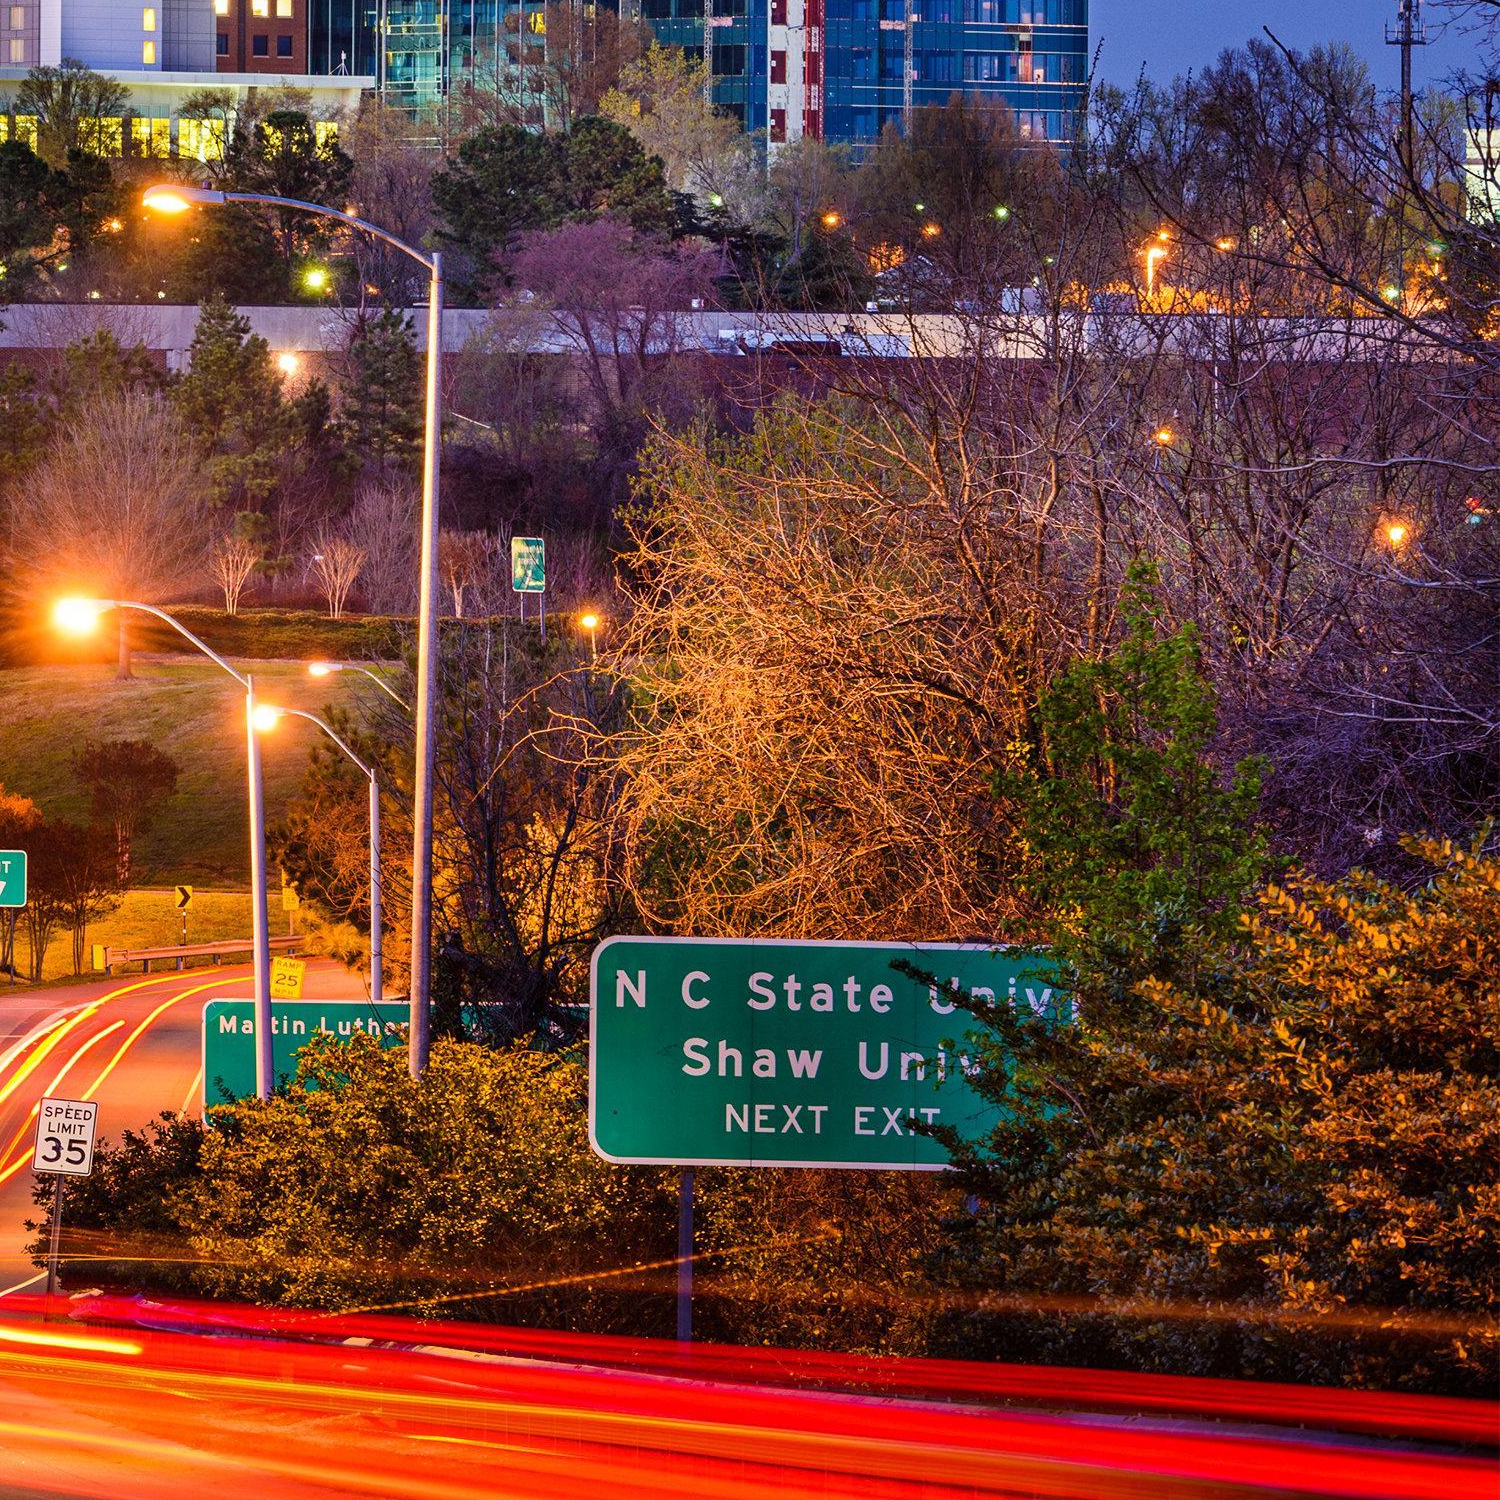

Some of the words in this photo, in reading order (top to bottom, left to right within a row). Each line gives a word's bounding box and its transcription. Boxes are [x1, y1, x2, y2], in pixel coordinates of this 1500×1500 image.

[276, 960, 302, 970] RAMP
[275, 973, 298, 987] 25
[615, 970, 646, 1008] N
[681, 971, 711, 1010] C
[746, 972, 893, 1014] State
[928, 976, 1053, 1017] Univ
[219, 1015, 305, 1034] Matin
[682, 1037, 823, 1078] Shaw
[45, 1106, 92, 1120] SPEED
[725, 1104, 829, 1134] NEXT
[854, 1106, 941, 1137] EXIT
[48, 1122, 85, 1135] LIMIT
[41, 1136, 87, 1165] 35
